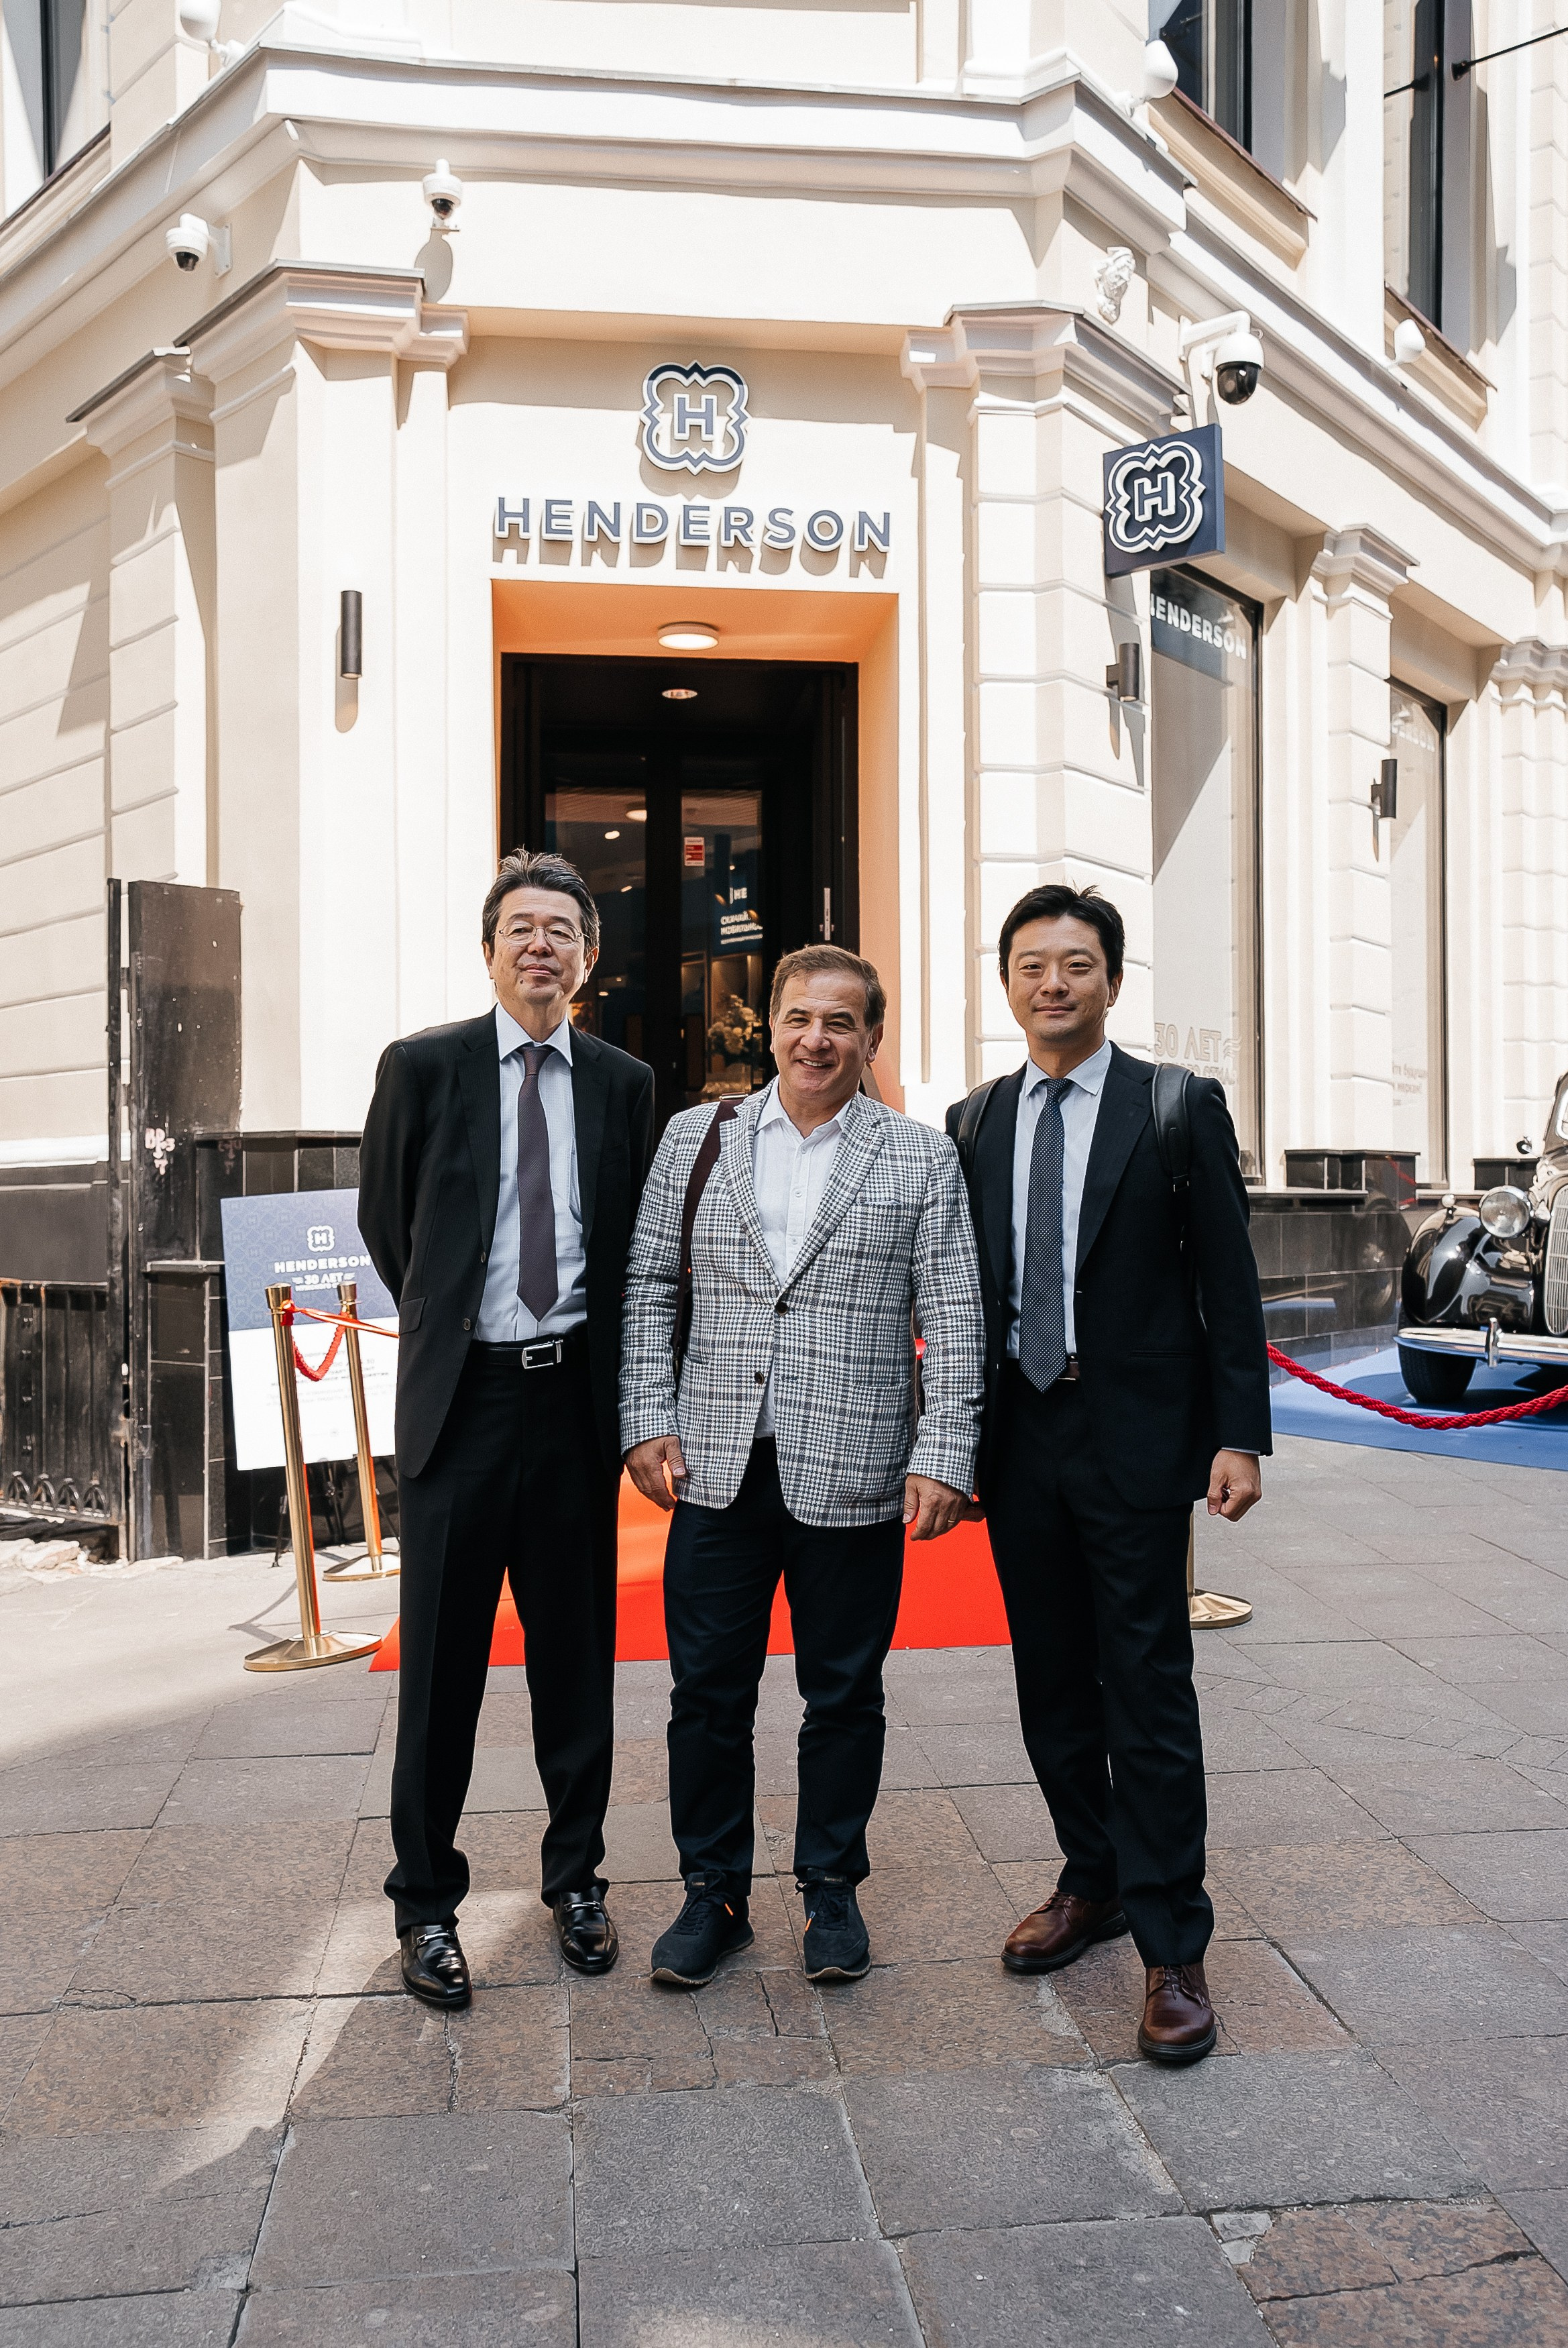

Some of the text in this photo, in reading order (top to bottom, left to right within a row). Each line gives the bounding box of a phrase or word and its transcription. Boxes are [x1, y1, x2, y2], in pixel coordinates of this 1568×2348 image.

[673, 392, 718, 441] H
[1134, 471, 1175, 523] H
[494, 496, 891, 552] HENDERSON
[1154, 1022, 1221, 1062] 30 ЛЕТ
[274, 1255, 372, 1273] HENDERSON
[304, 1272, 343, 1285] 30 ЛЕТ
